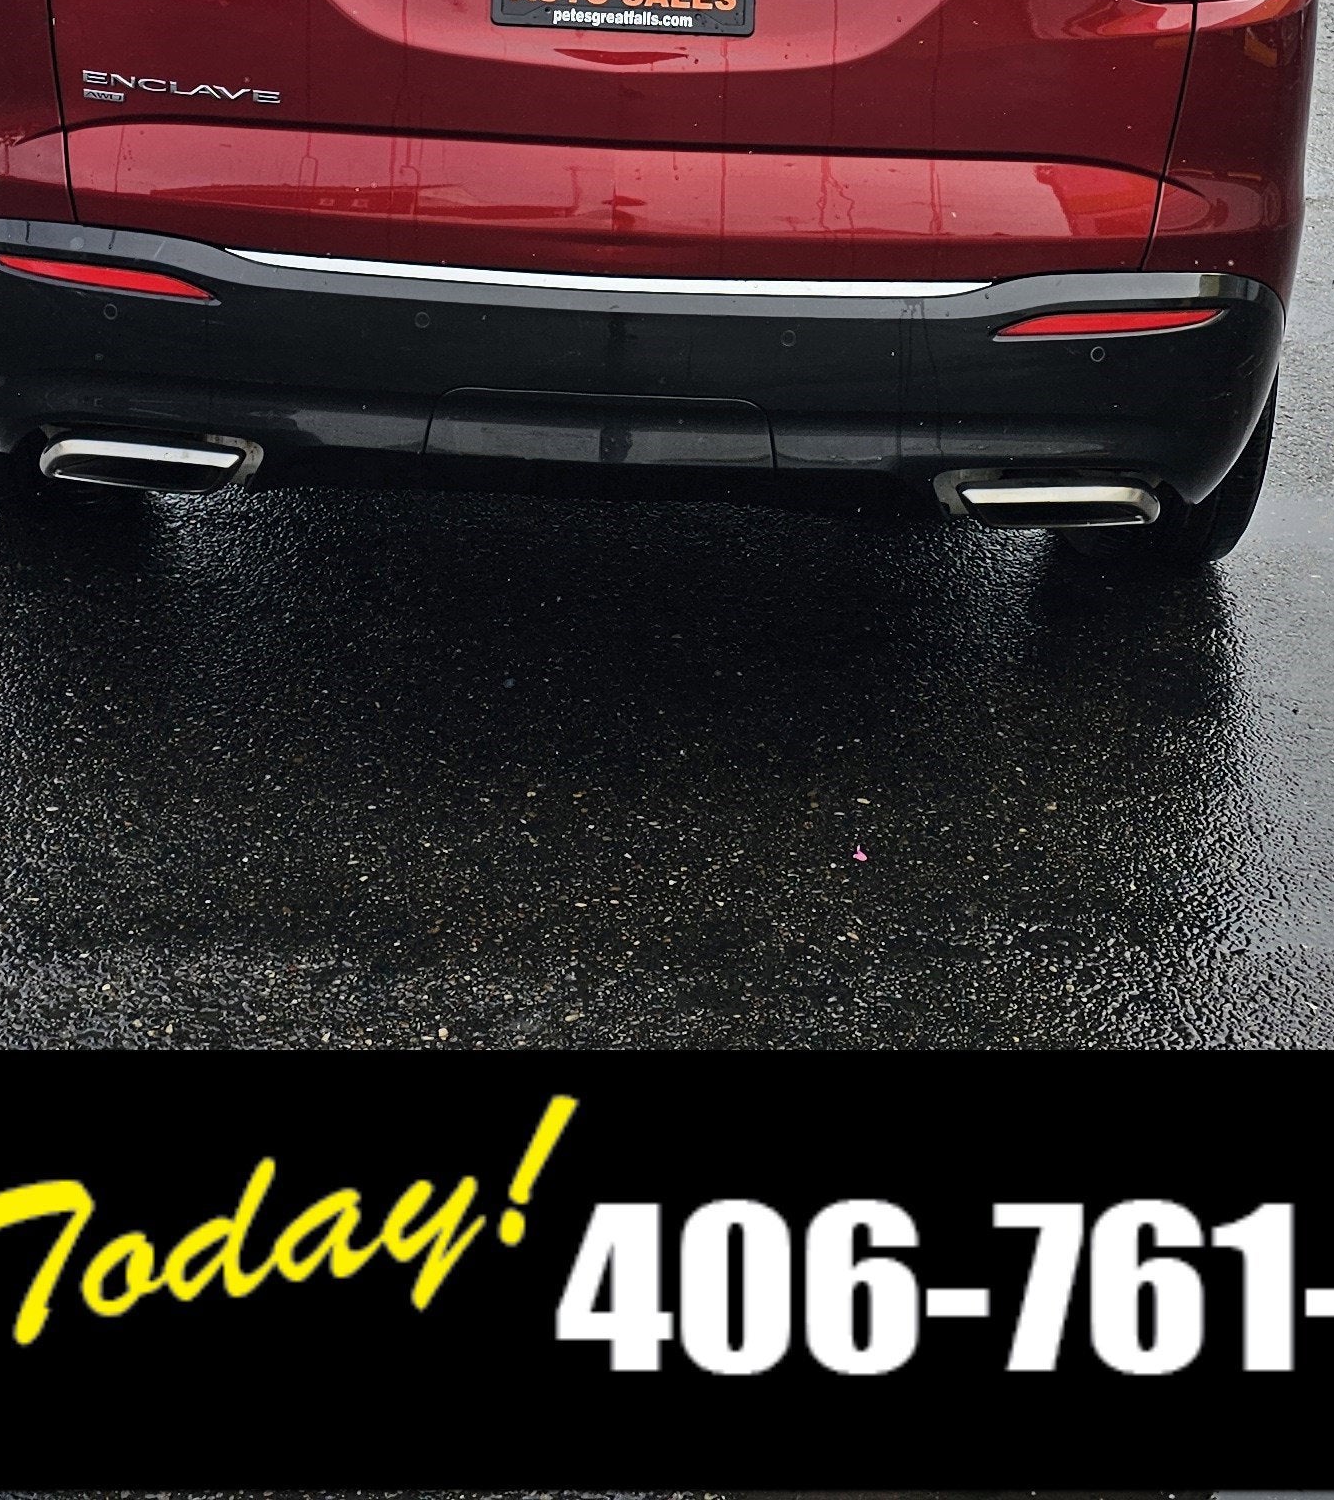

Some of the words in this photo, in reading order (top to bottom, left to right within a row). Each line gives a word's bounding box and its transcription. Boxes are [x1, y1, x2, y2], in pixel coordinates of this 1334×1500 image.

[553, 7, 693, 27] petesgreatfalls.com
[82, 69, 281, 103] ENCLAVE
[84, 89, 124, 102] AWD
